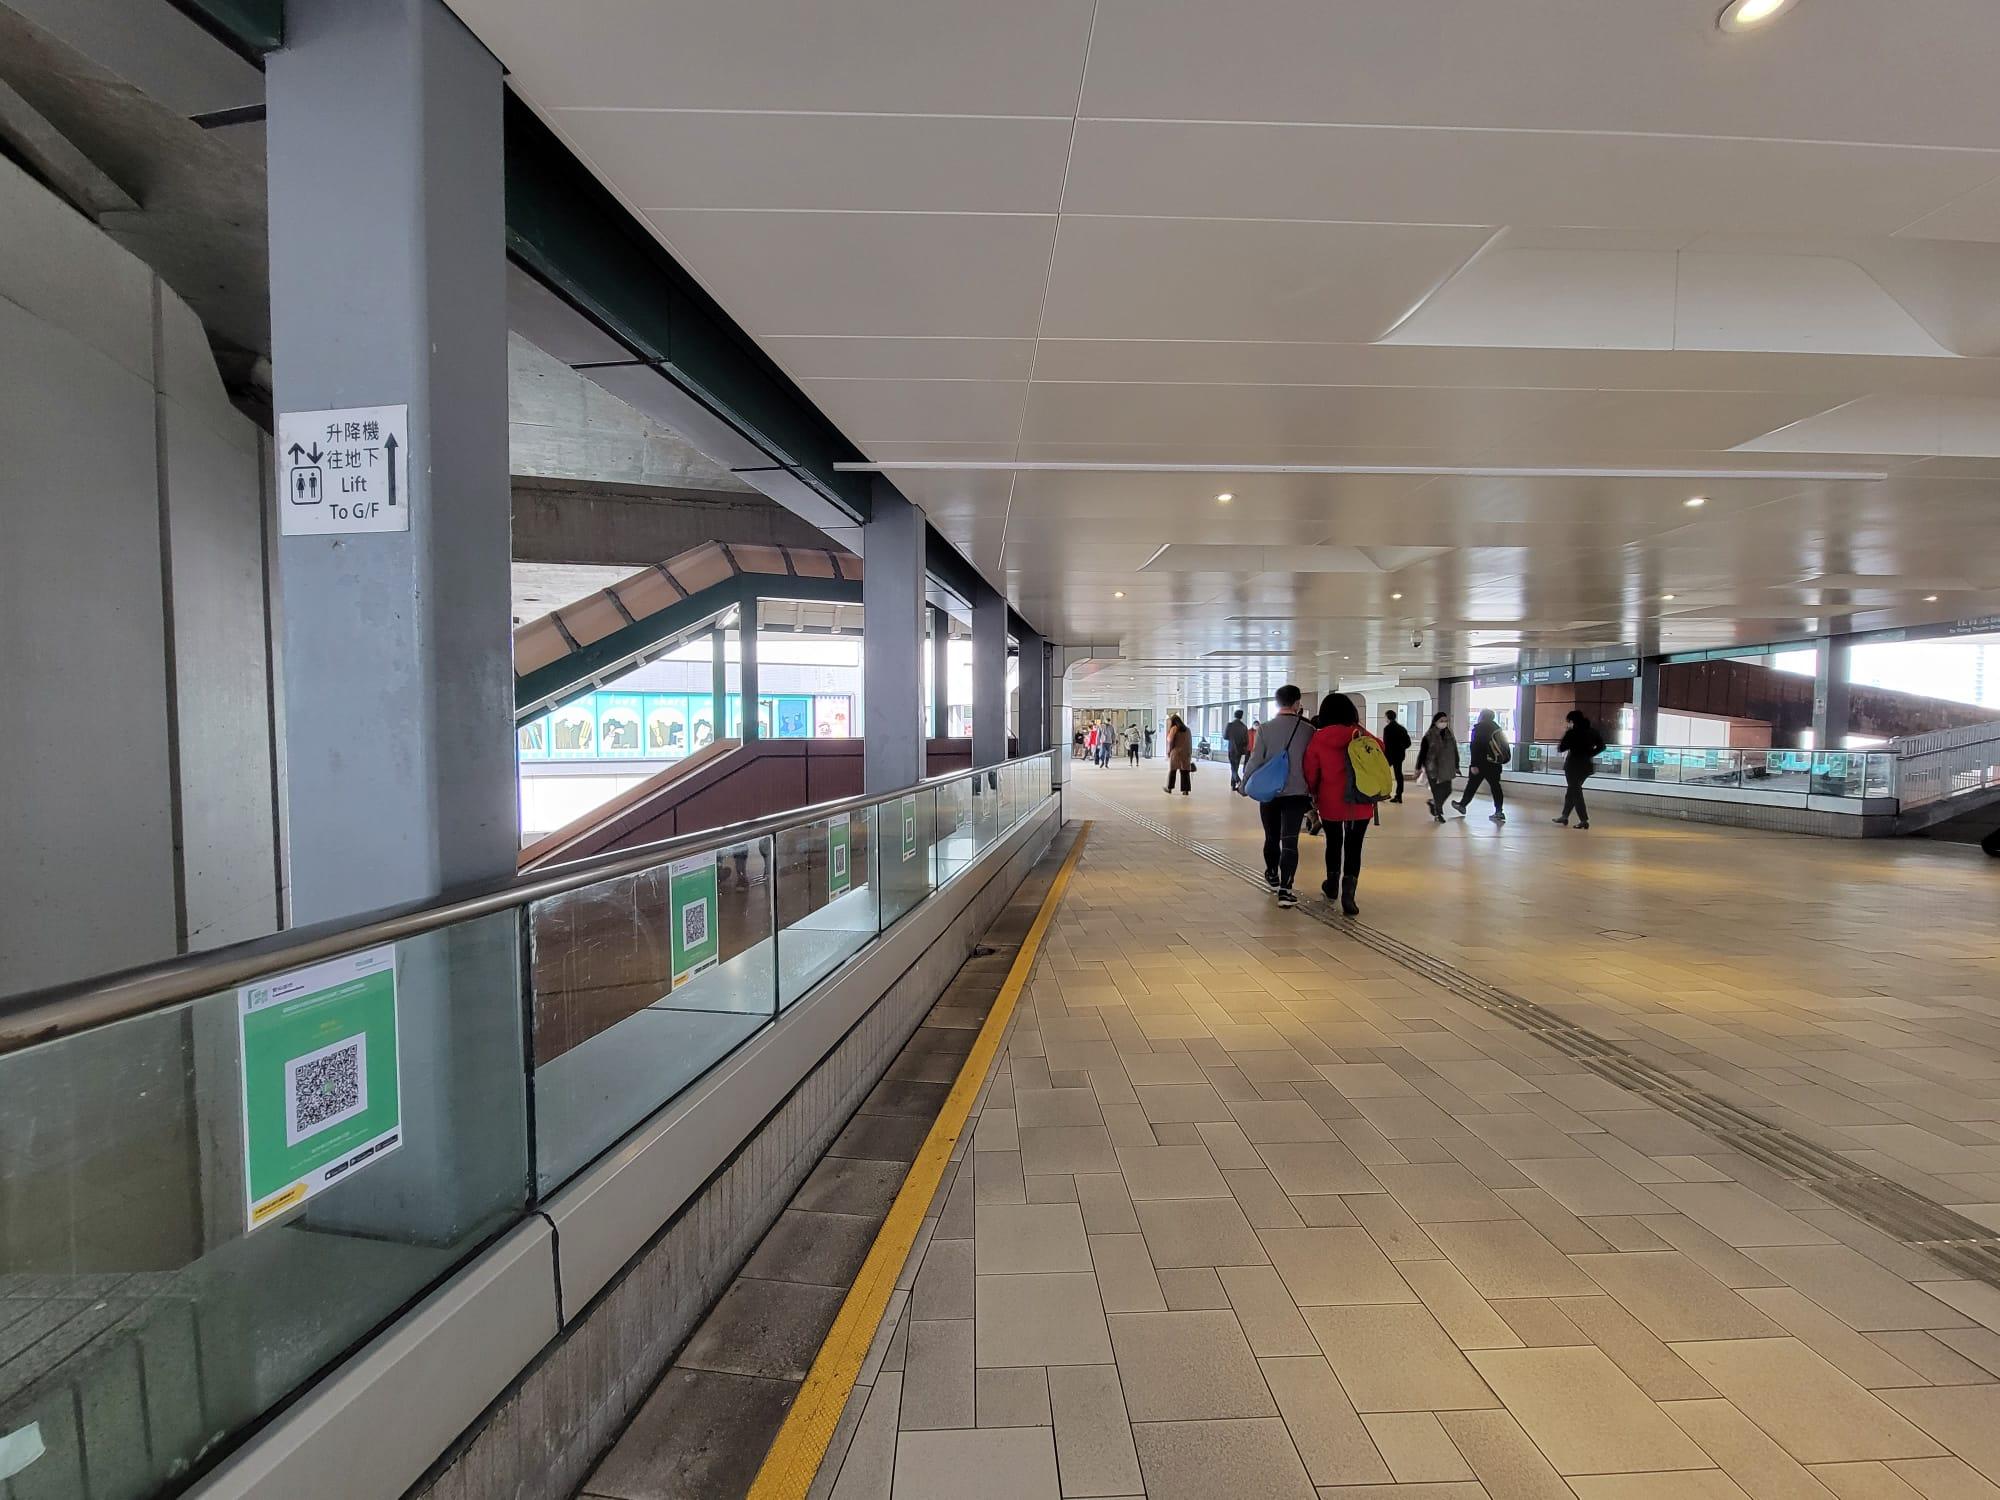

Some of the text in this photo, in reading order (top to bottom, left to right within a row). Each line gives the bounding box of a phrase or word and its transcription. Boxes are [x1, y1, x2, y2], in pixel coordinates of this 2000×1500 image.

[326, 420, 379, 443] 升降機
[327, 447, 379, 469] 往地下
[342, 476, 367, 493] Lift
[329, 502, 379, 519] To G/F
